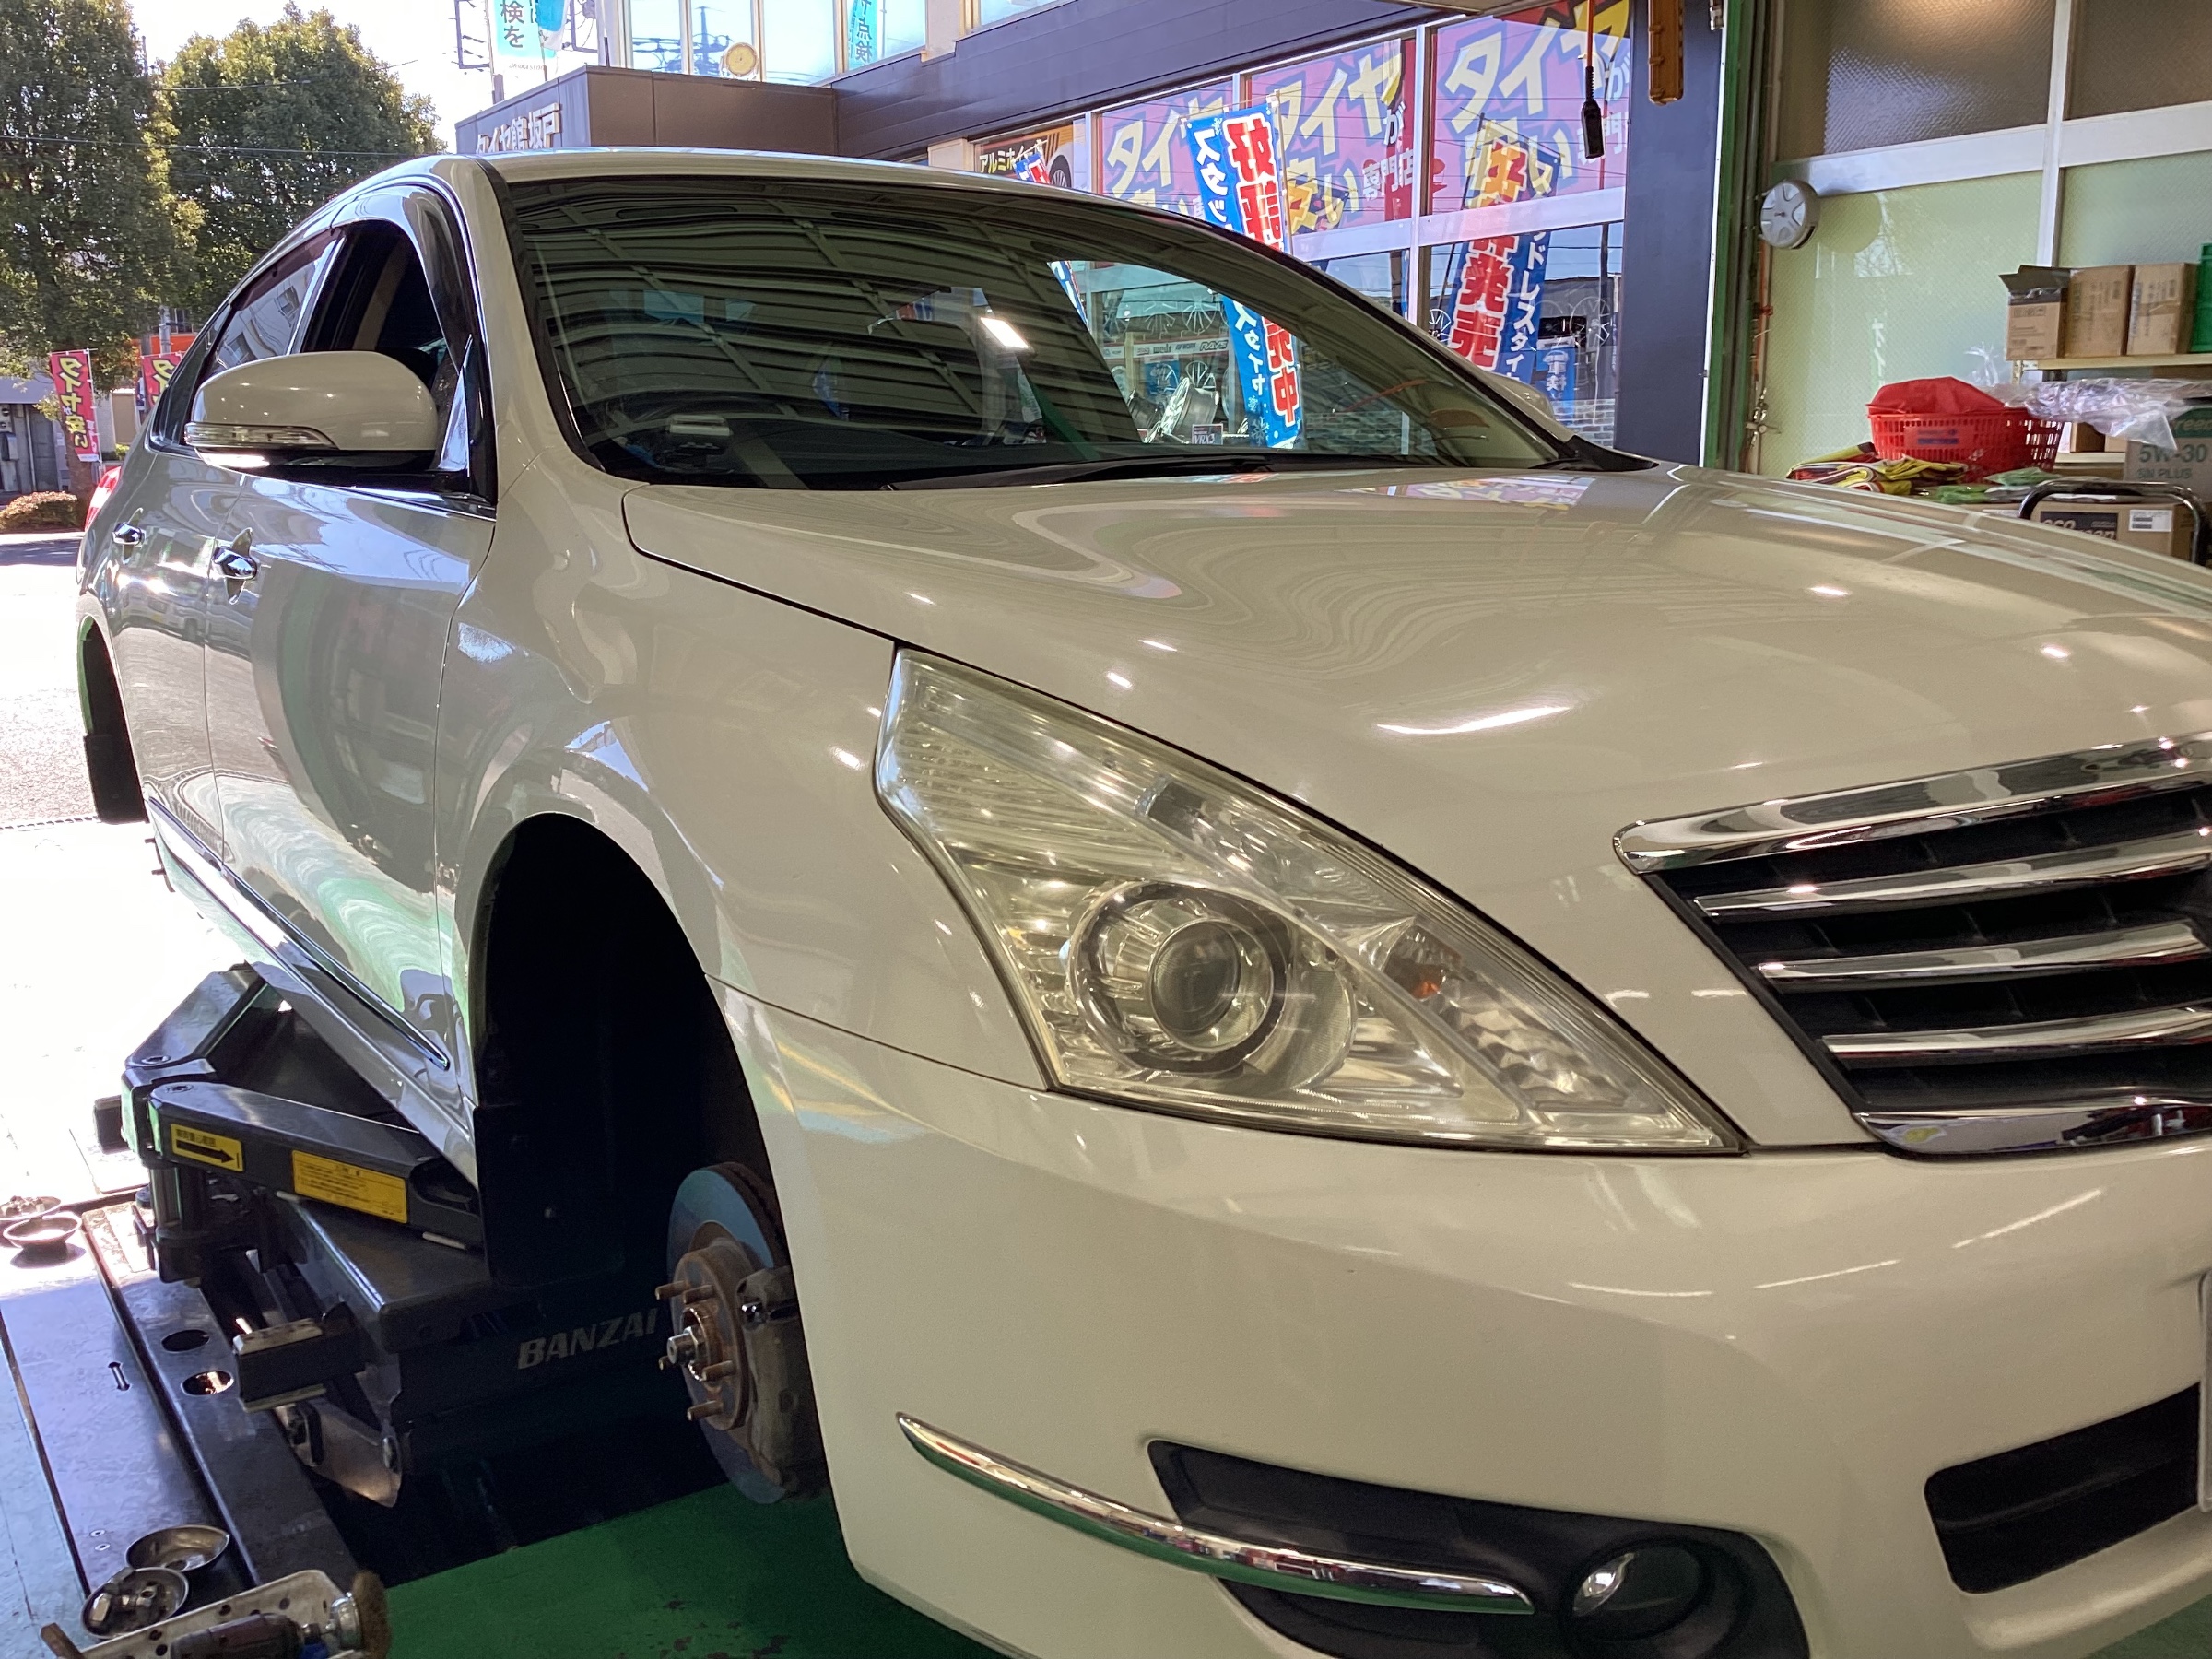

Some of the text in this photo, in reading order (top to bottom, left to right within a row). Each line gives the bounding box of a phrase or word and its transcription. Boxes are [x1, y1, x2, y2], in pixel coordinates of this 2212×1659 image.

[1383, 100, 1406, 146] が
[1200, 340, 1228, 351] RAYS
[517, 1308, 657, 1370] BANZAI
